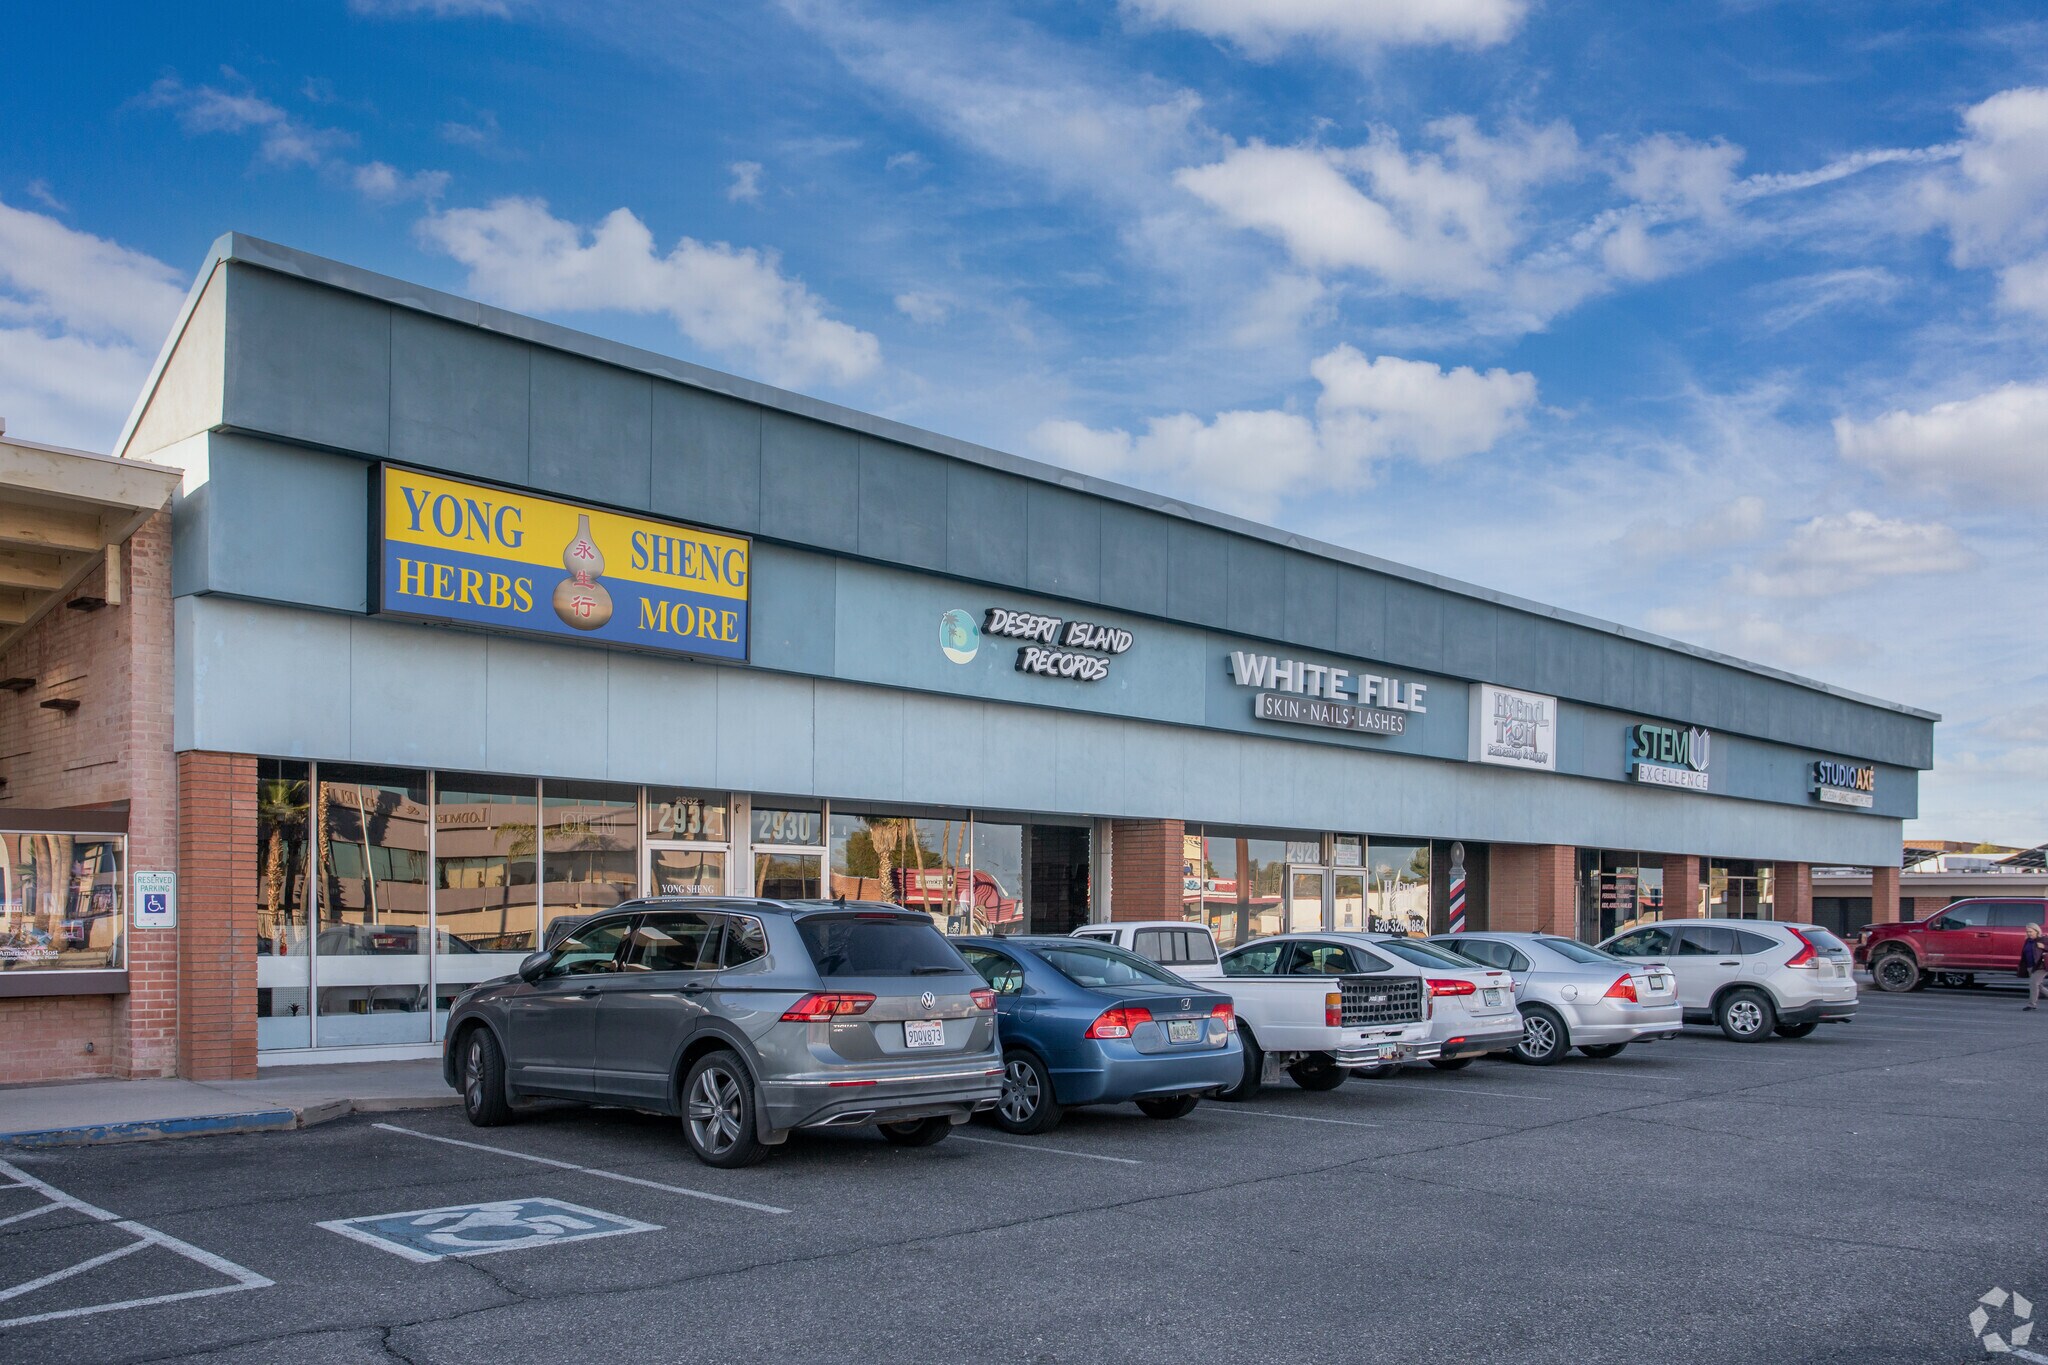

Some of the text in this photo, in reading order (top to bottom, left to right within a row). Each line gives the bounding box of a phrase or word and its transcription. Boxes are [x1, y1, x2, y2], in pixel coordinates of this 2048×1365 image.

[400, 486, 746, 588] YONG SHENG
[571, 539, 598, 619] 永生行
[395, 557, 740, 643] HERBS MORE
[988, 608, 1133, 654] DESERT ISLAND
[1021, 646, 1110, 681] RECORDS
[1230, 651, 1427, 713] WHITE FILE
[1265, 697, 1404, 733] SKIN NAILS LASHES
[1639, 725, 1688, 764] STEM
[1640, 765, 1708, 788] EXCELLENCE
[564, 813, 614, 834] OPEN
[658, 803, 716, 834] 2932
[759, 811, 811, 840] 2930
[1289, 842, 1320, 863] 2928
[138, 876, 172, 884] RESERVED
[662, 884, 714, 894] YONG SHENG
